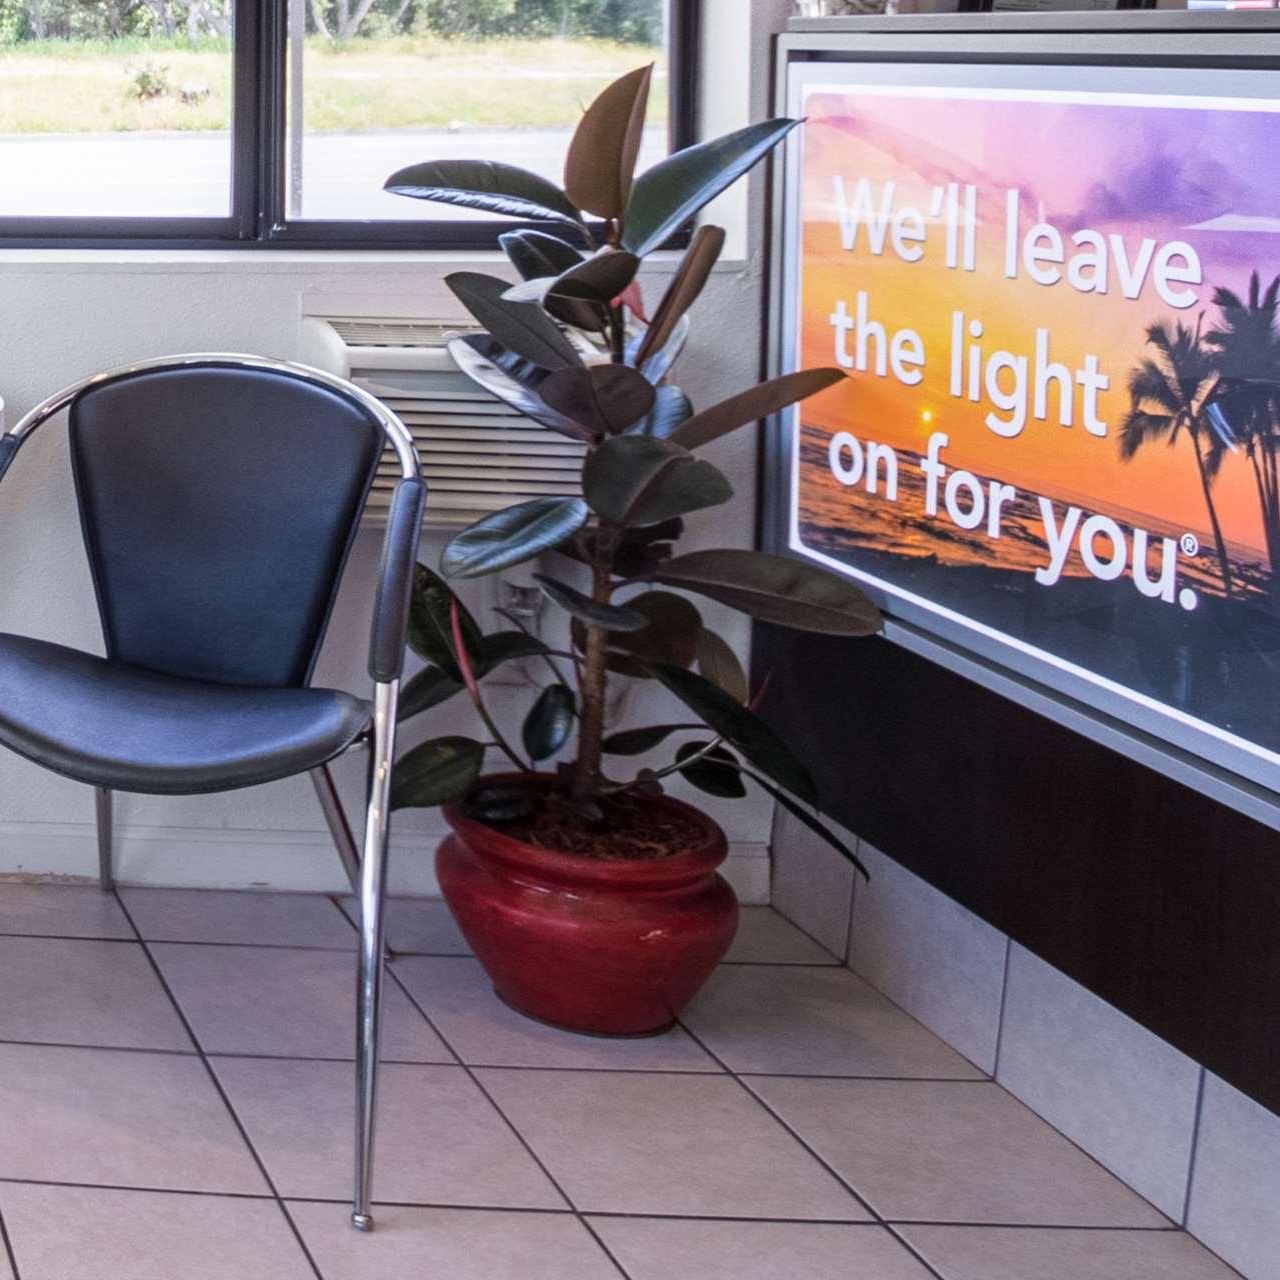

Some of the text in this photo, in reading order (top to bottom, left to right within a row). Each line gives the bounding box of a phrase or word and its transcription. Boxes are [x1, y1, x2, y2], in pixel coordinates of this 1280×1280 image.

[833, 175, 1202, 309] We'll leave
[829, 291, 1110, 438] the light
[829, 430, 898, 502] on
[920, 433, 1015, 539] for
